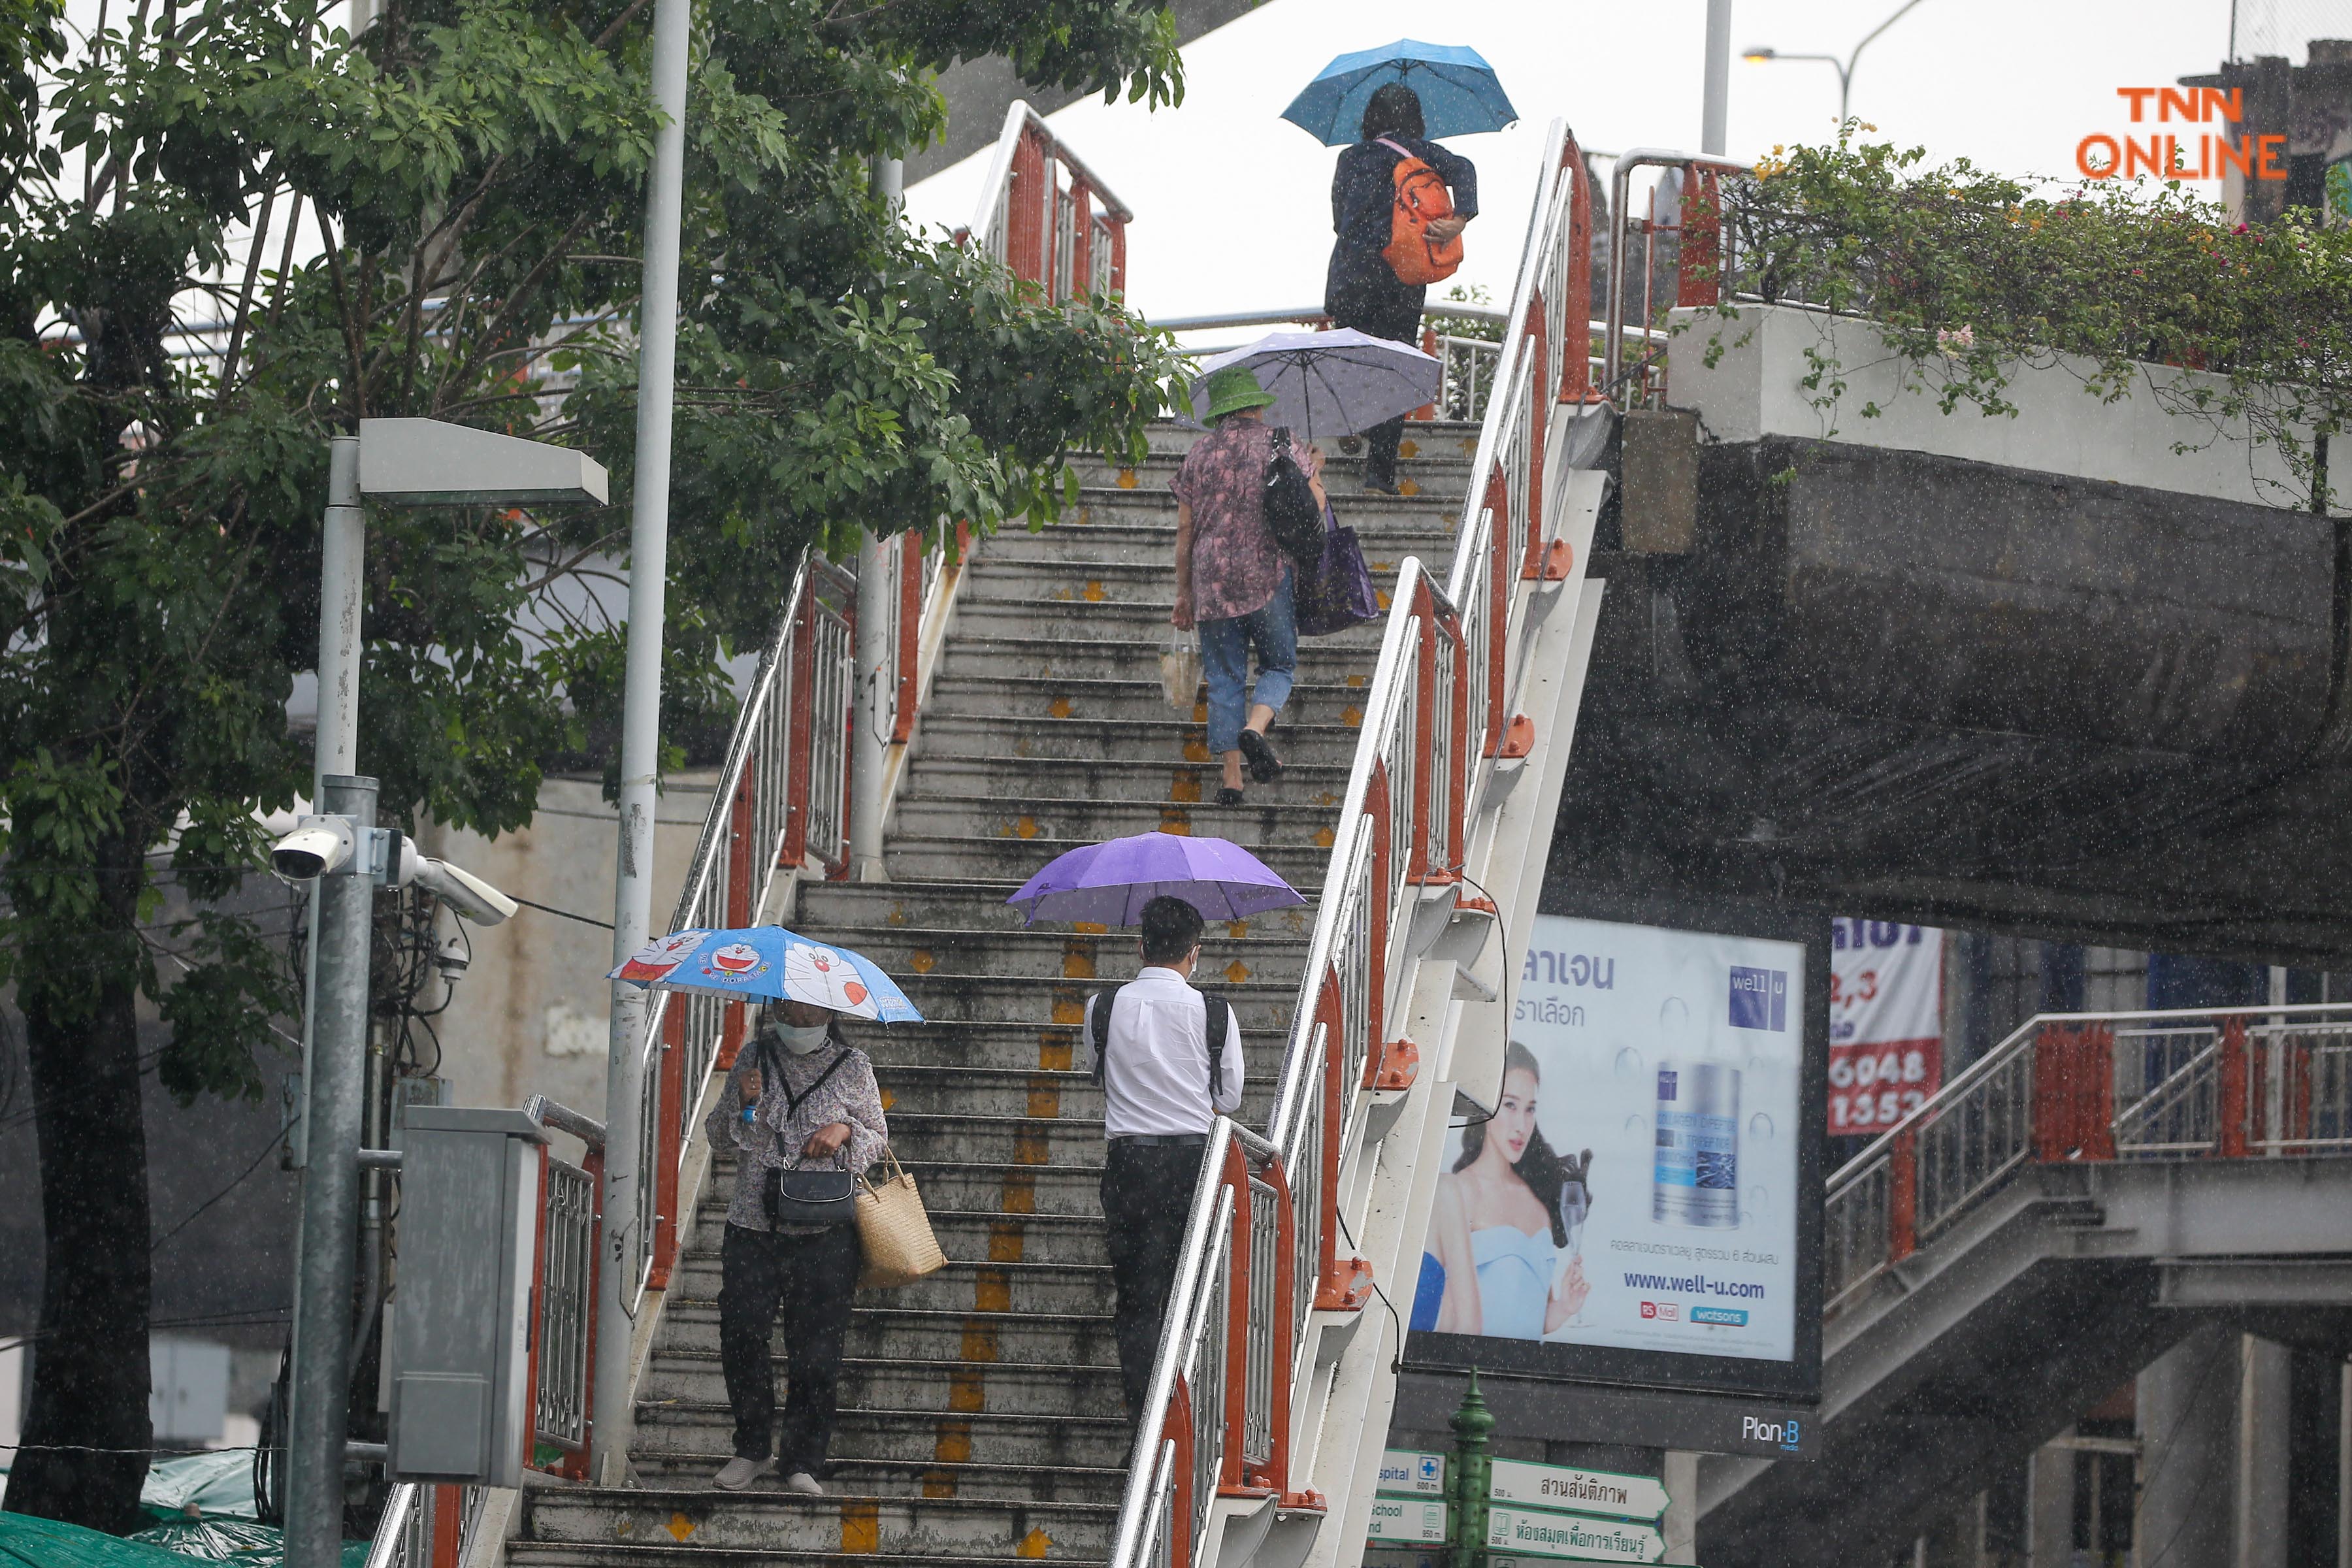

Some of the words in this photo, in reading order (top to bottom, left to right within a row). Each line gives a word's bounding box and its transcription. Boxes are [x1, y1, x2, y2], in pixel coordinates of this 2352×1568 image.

[1732, 974, 1767, 992] well
[1829, 1050, 1926, 1089] 6048
[1624, 1273, 1765, 1299] www.well-u.com
[1697, 1309, 1742, 1323] watsons
[1541, 1474, 1627, 1504] สวนสันติภาพ
